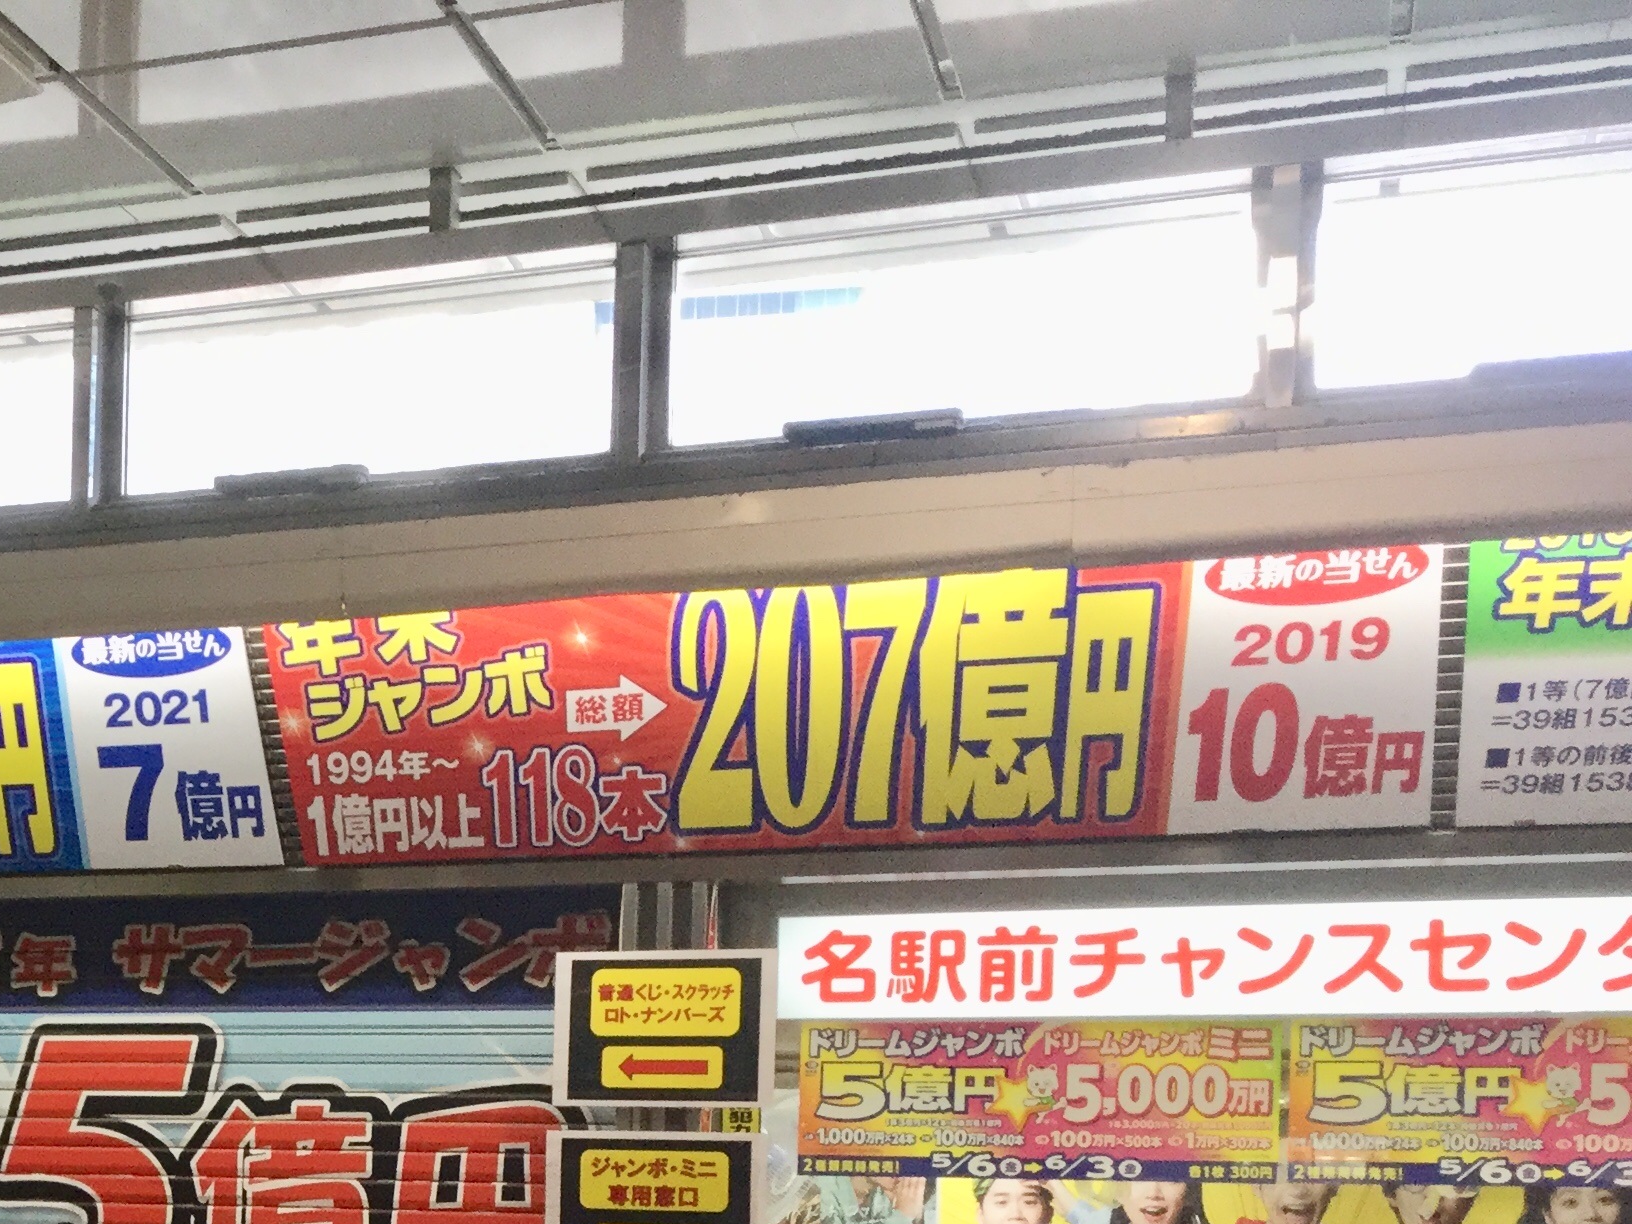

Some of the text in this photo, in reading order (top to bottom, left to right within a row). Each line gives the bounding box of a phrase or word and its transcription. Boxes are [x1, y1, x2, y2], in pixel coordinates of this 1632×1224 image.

[1218, 547, 1419, 593] 最新の当せん
[80, 632, 226, 666] 最新の当せん
[1230, 616, 1391, 667] 2019
[103, 688, 211, 728] 2021
[308, 566, 1159, 830] ジャンボ 総額 207億円
[1187, 682, 1426, 803] 10億円
[97, 743, 265, 843] 7億円
[307, 744, 667, 857] 1億円以上 118本
[604, 1005, 726, 1024] ロト・ナンバーズ
[809, 1027, 1027, 1059] ドリームジャンボ
[1300, 1024, 1546, 1057] ドリームジャンボ
[815, 1060, 1009, 1123] 5億円
[1062, 1062, 1273, 1125] 5,000万円
[1307, 1060, 1524, 1126] 5億円
[590, 1156, 718, 1179] ジャンボ・ミニ
[607, 1184, 700, 1208] 専用窓口
